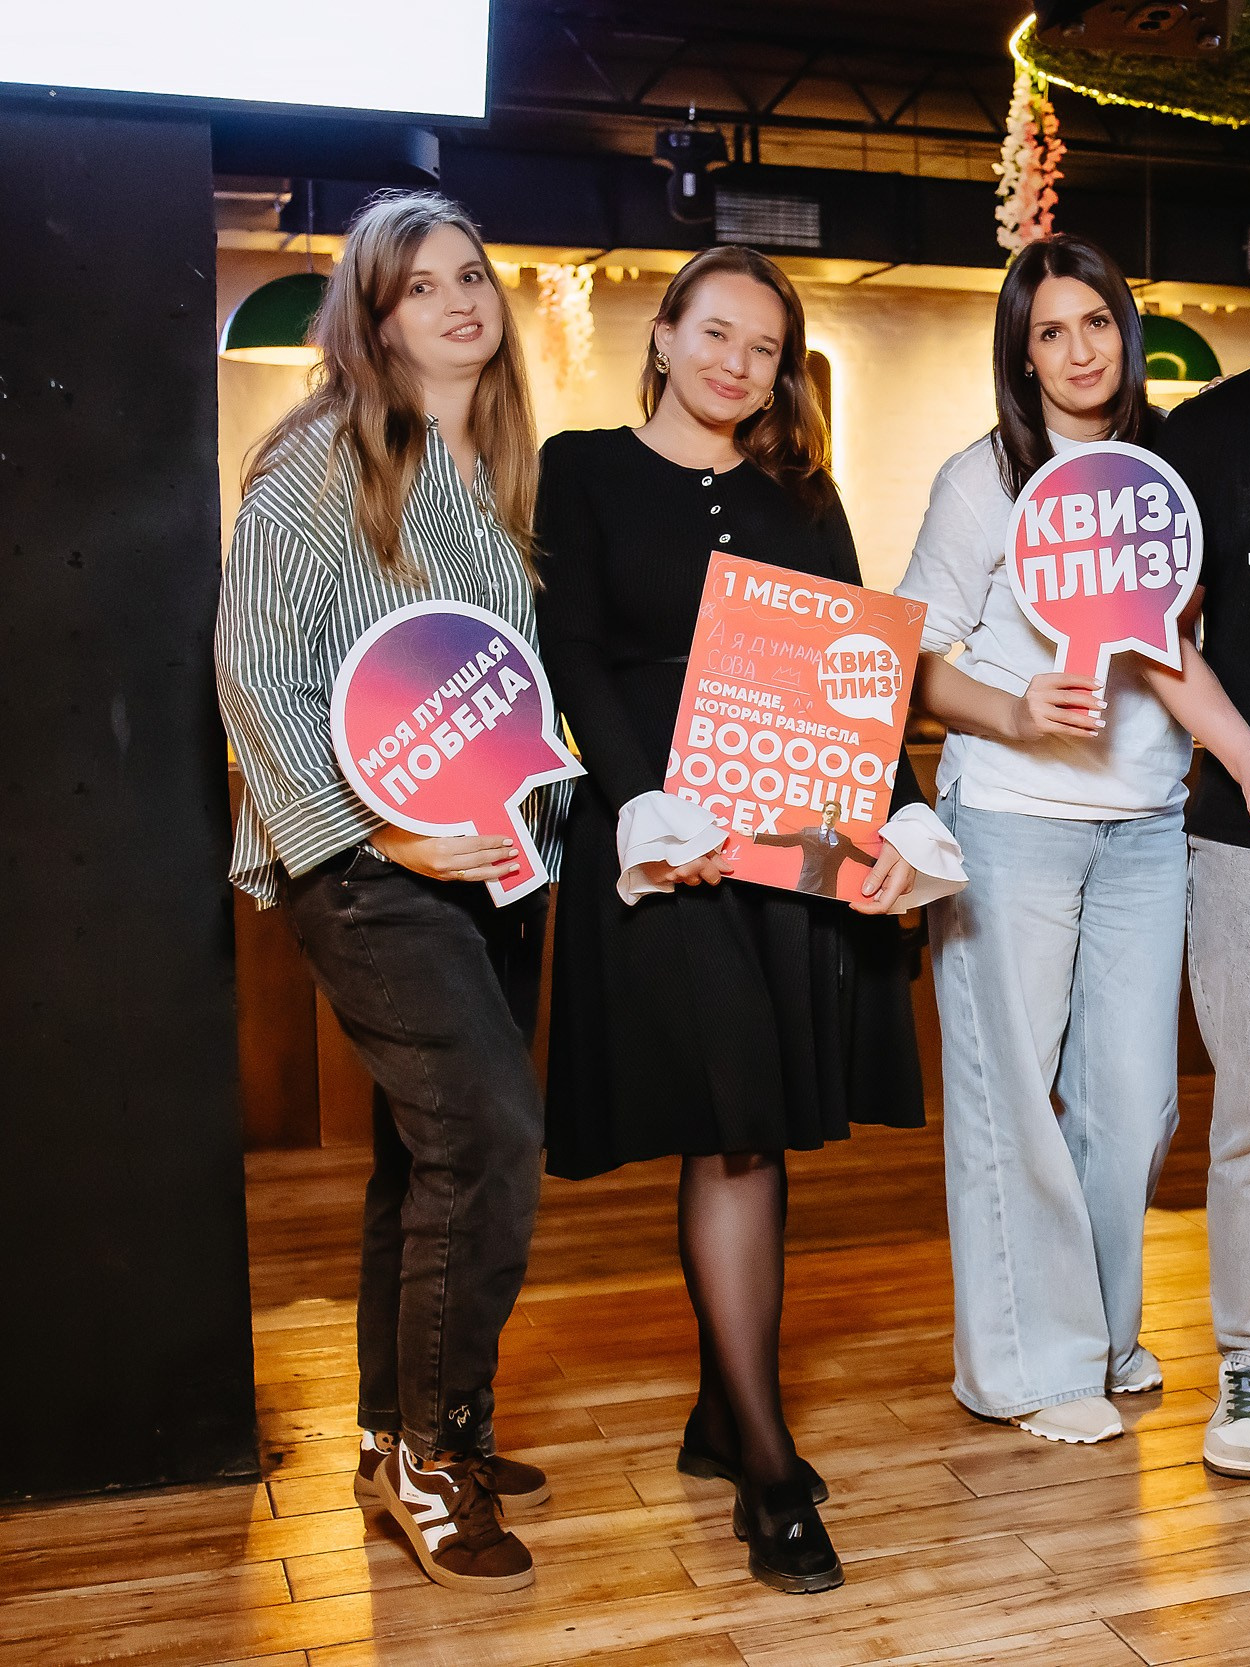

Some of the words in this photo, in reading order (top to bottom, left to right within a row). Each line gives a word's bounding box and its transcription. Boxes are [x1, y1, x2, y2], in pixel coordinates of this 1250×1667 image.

[1023, 482, 1188, 547] КВИЗ,
[1022, 537, 1191, 604] ПЛИЗ!
[723, 571, 737, 598] 1
[743, 576, 854, 624] МЕСТО
[820, 675, 902, 701] ПЛИЗ!
[821, 650, 901, 675] КВИЗ,
[358, 720, 417, 778] МОЯ
[411, 636, 509, 730] ЛУЧШАЯ
[693, 697, 773, 727] КОТОРАЯ
[775, 715, 860, 746] РАЗНЕСЛА
[698, 678, 786, 712] КОМАНДЕ,
[379, 665, 532, 806] ПОБЕДА
